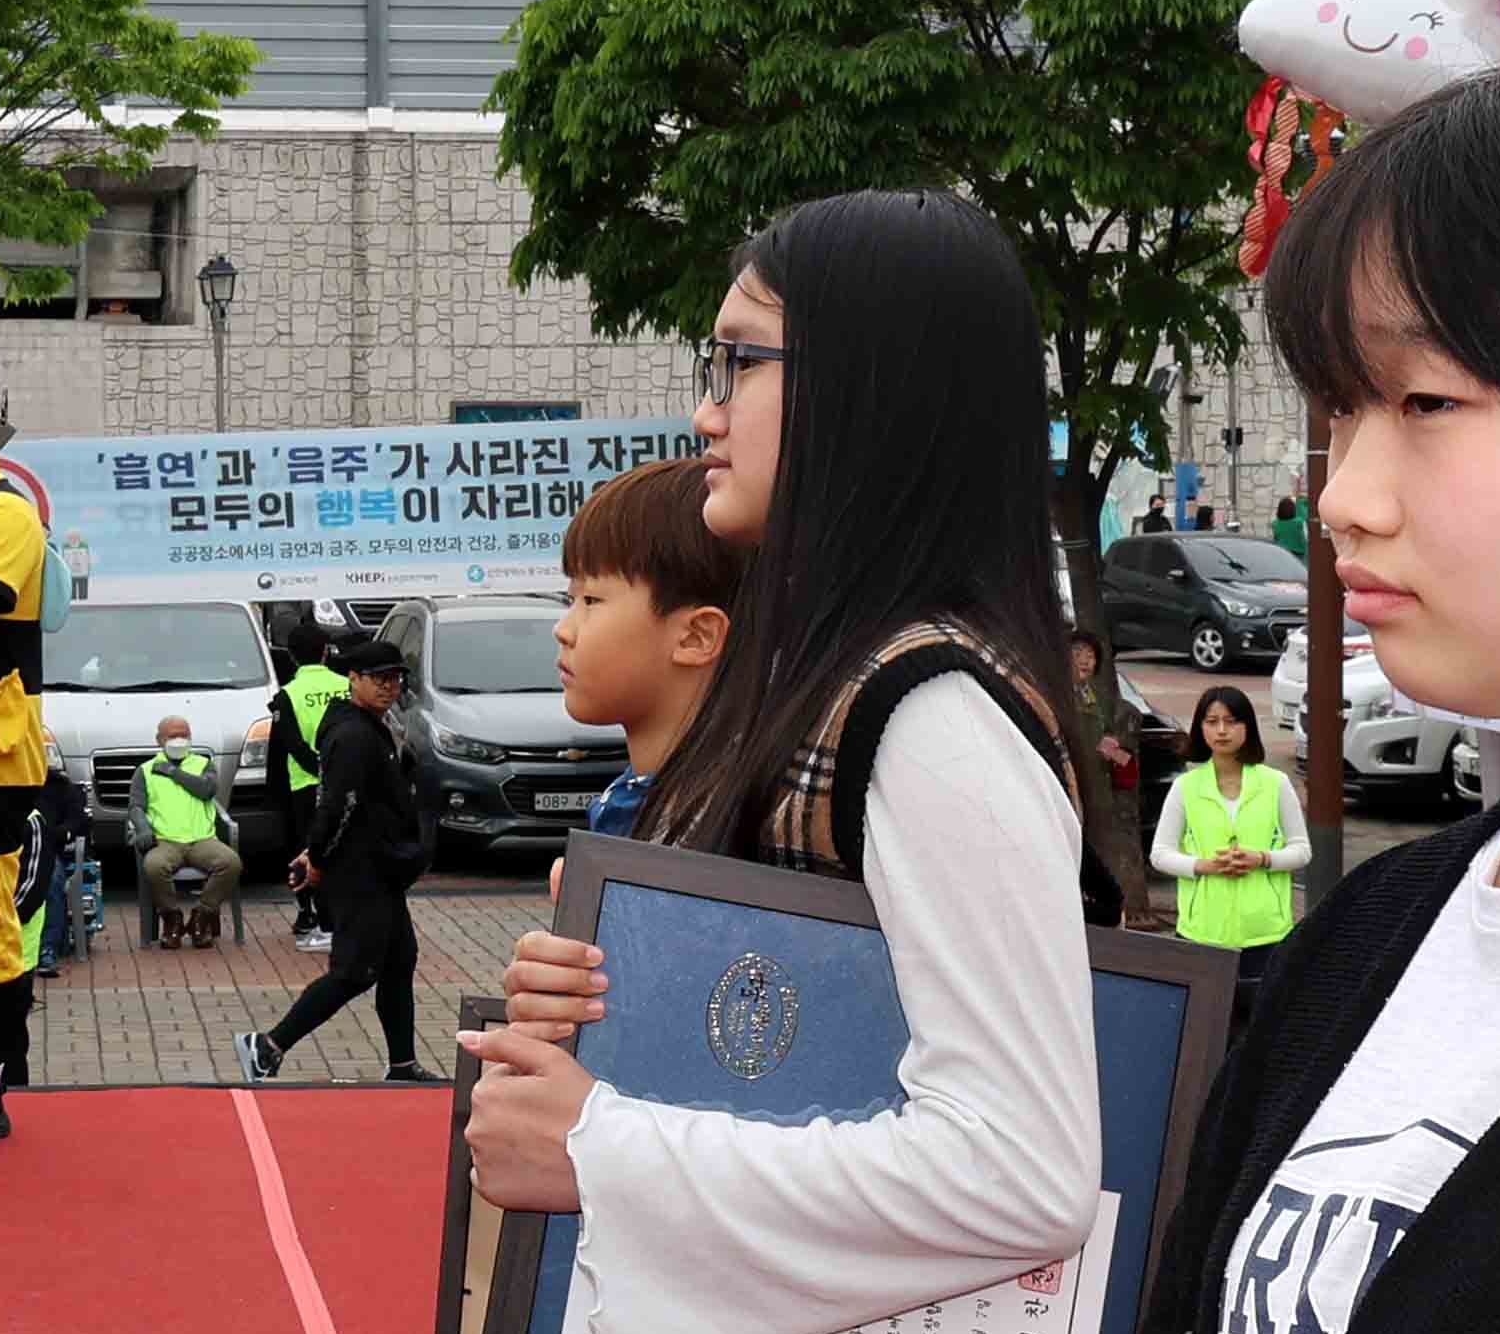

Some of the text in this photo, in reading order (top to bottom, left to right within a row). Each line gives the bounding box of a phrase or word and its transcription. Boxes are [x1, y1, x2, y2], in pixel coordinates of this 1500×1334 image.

[446, 436, 570, 477] 사라진
[170, 480, 608, 531] 모두의 행복이 자리해
[168, 542, 275, 563] 공공장소에서의
[279, 540, 324, 559] 금연과
[368, 536, 413, 555] 모두의
[417, 535, 463, 554] 안전과
